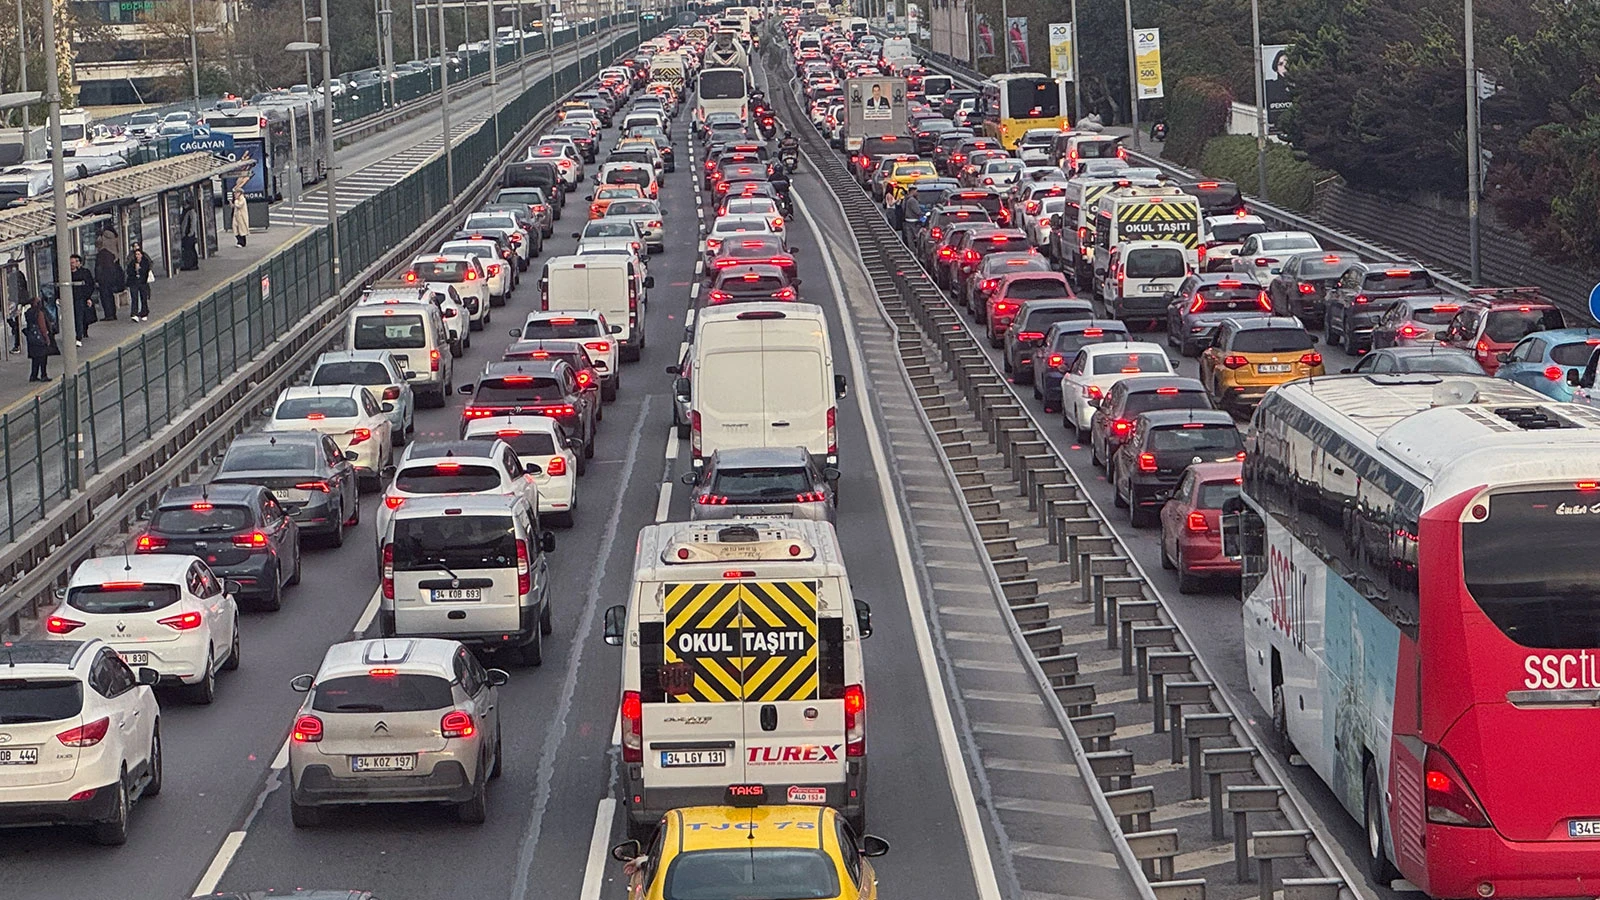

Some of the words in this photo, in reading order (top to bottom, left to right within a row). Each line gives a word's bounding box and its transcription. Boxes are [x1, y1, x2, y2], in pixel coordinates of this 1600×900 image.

[1139, 33, 1154, 42] 20
[180, 141, 225, 151] ÇAĞLAYAN
[1125, 224, 1154, 232] OKUL
[1157, 223, 1190, 232] TAŞITI
[436, 590, 444, 598] 34
[466, 590, 479, 598] 693
[679, 633, 733, 652] OKUL
[742, 632, 803, 655] TAŞITI
[133, 654, 146, 662] 830
[19, 750, 36, 760] 444
[668, 753, 680, 764] 34
[685, 753, 702, 763] LGY
[708, 752, 722, 762] 131
[747, 744, 842, 762] TUREX
[358, 759, 369, 768] 34
[396, 757, 410, 767] 197
[773, 821, 815, 830] 75
